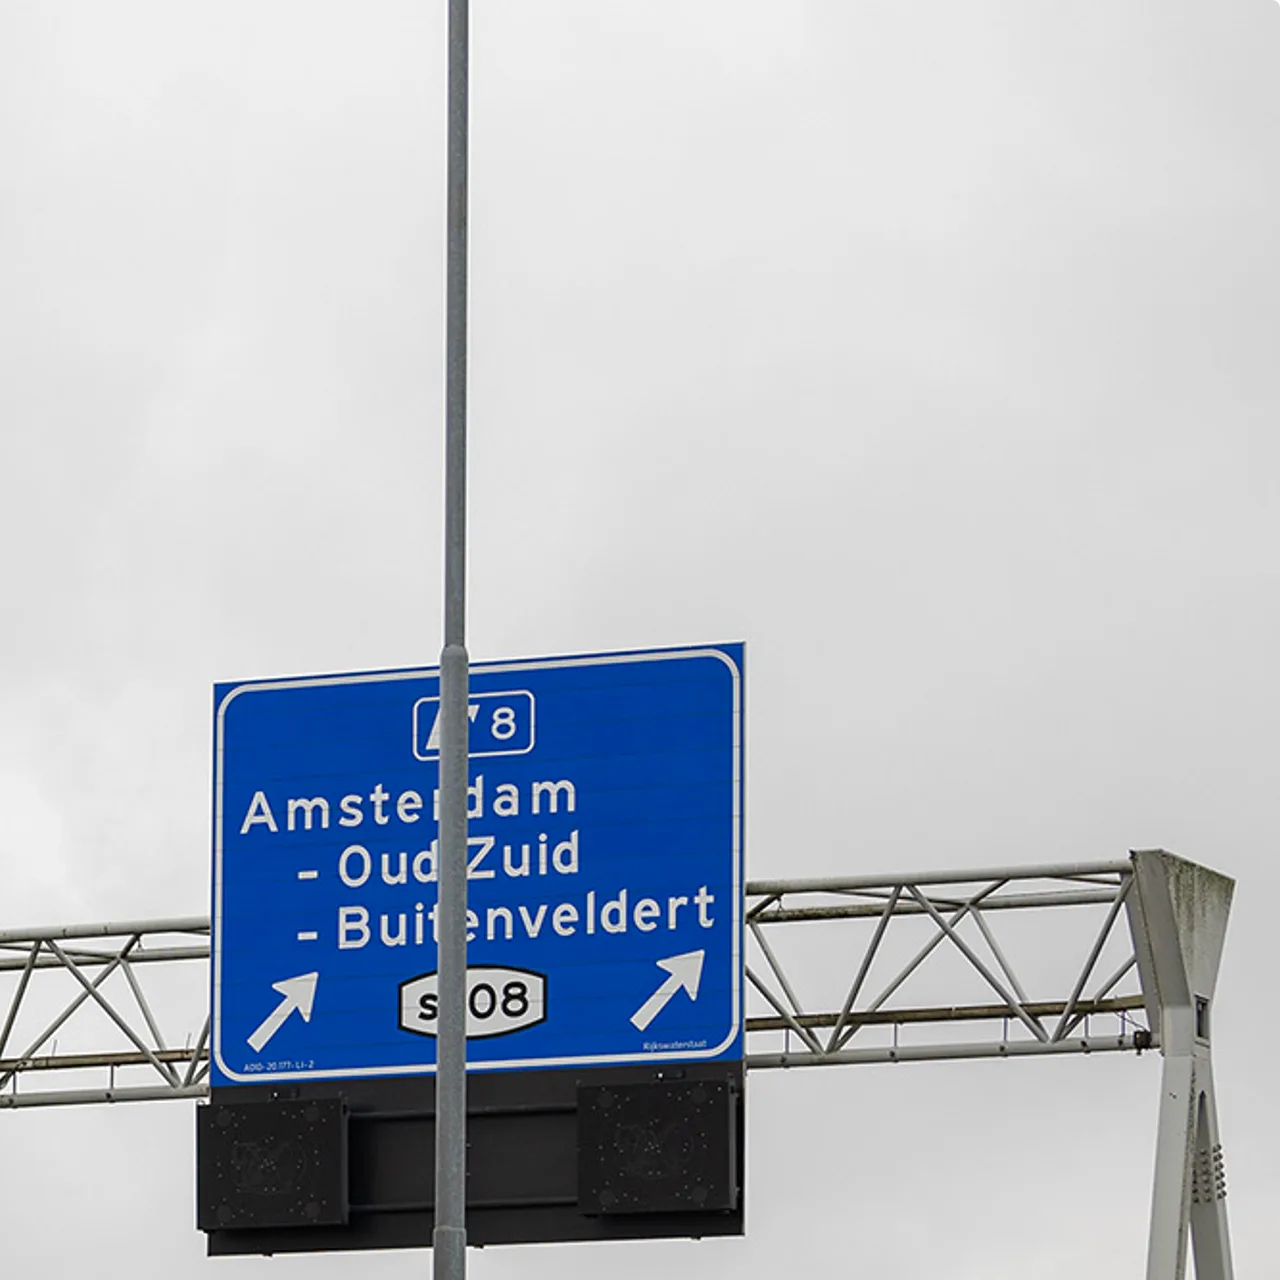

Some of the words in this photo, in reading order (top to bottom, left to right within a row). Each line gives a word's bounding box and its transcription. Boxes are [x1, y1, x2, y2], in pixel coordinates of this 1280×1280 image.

[492, 707, 516, 740] 8
[339, 839, 440, 887] Oud
[466, 830, 579, 880] Zuid
[418, 981, 529, 1020] s08
